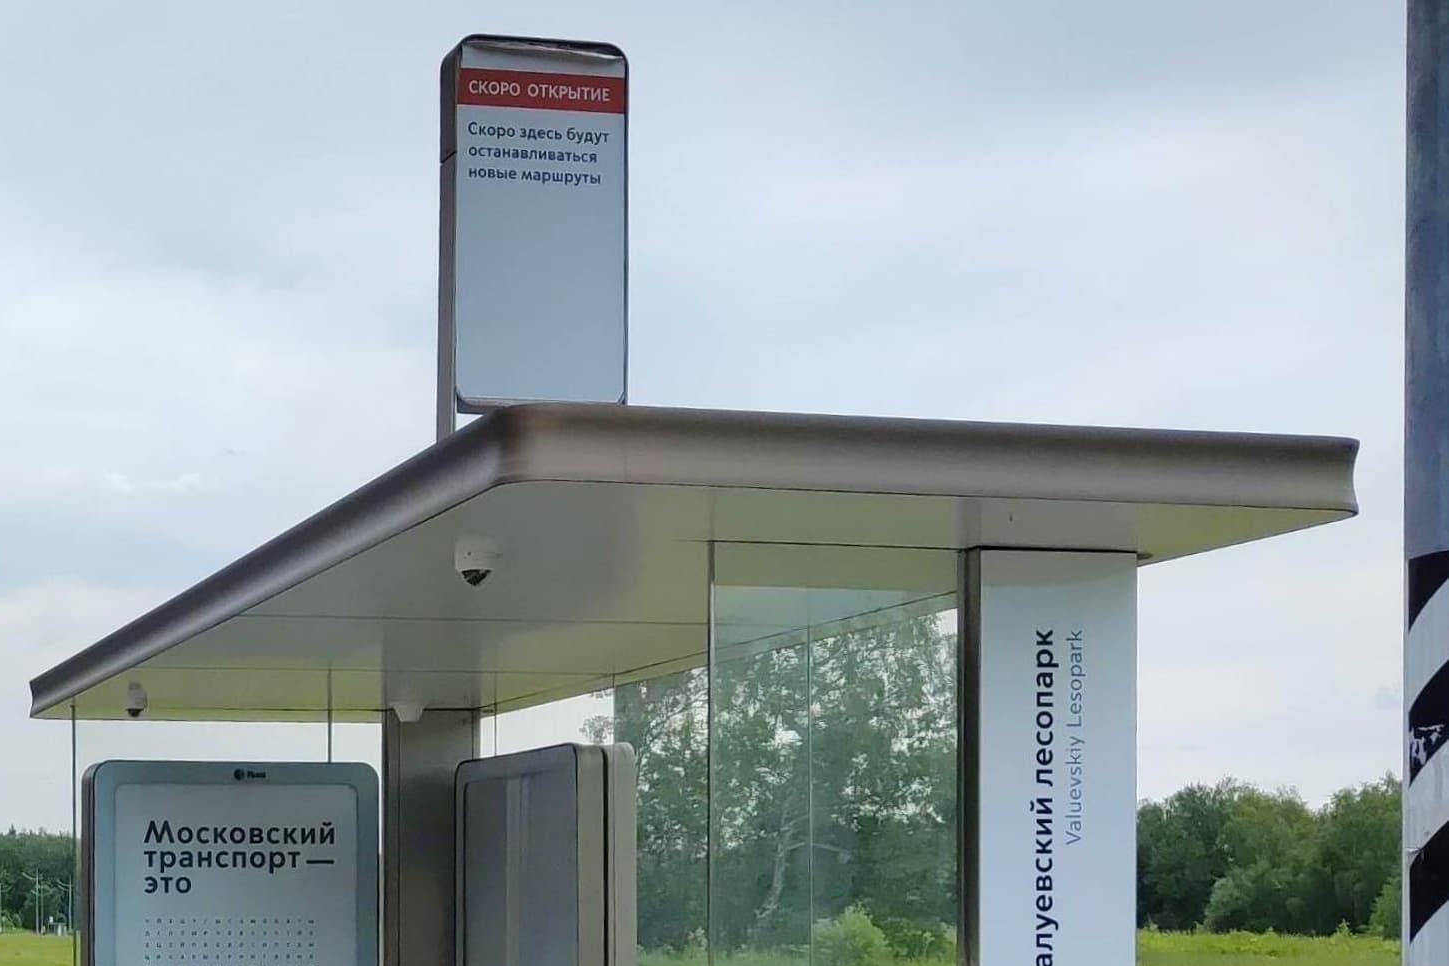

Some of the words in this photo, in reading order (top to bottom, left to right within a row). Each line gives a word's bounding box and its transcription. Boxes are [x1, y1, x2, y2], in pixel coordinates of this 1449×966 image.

[468, 79, 521, 97] СКОРО
[527, 83, 611, 102] ОТКРЫТИЕ
[467, 121, 516, 139] Скоро
[519, 127, 563, 141] здесь
[566, 128, 611, 145] будут
[468, 146, 598, 164] останавливаться
[468, 167, 518, 180] новые
[521, 171, 602, 186] маршруты
[1064, 629, 1086, 728] Lesopark
[1035, 628, 1059, 787] лесопарк
[1064, 736, 1086, 845] Valuevskiy
[143, 820, 335, 845] Московский
[144, 876, 192, 894] это
